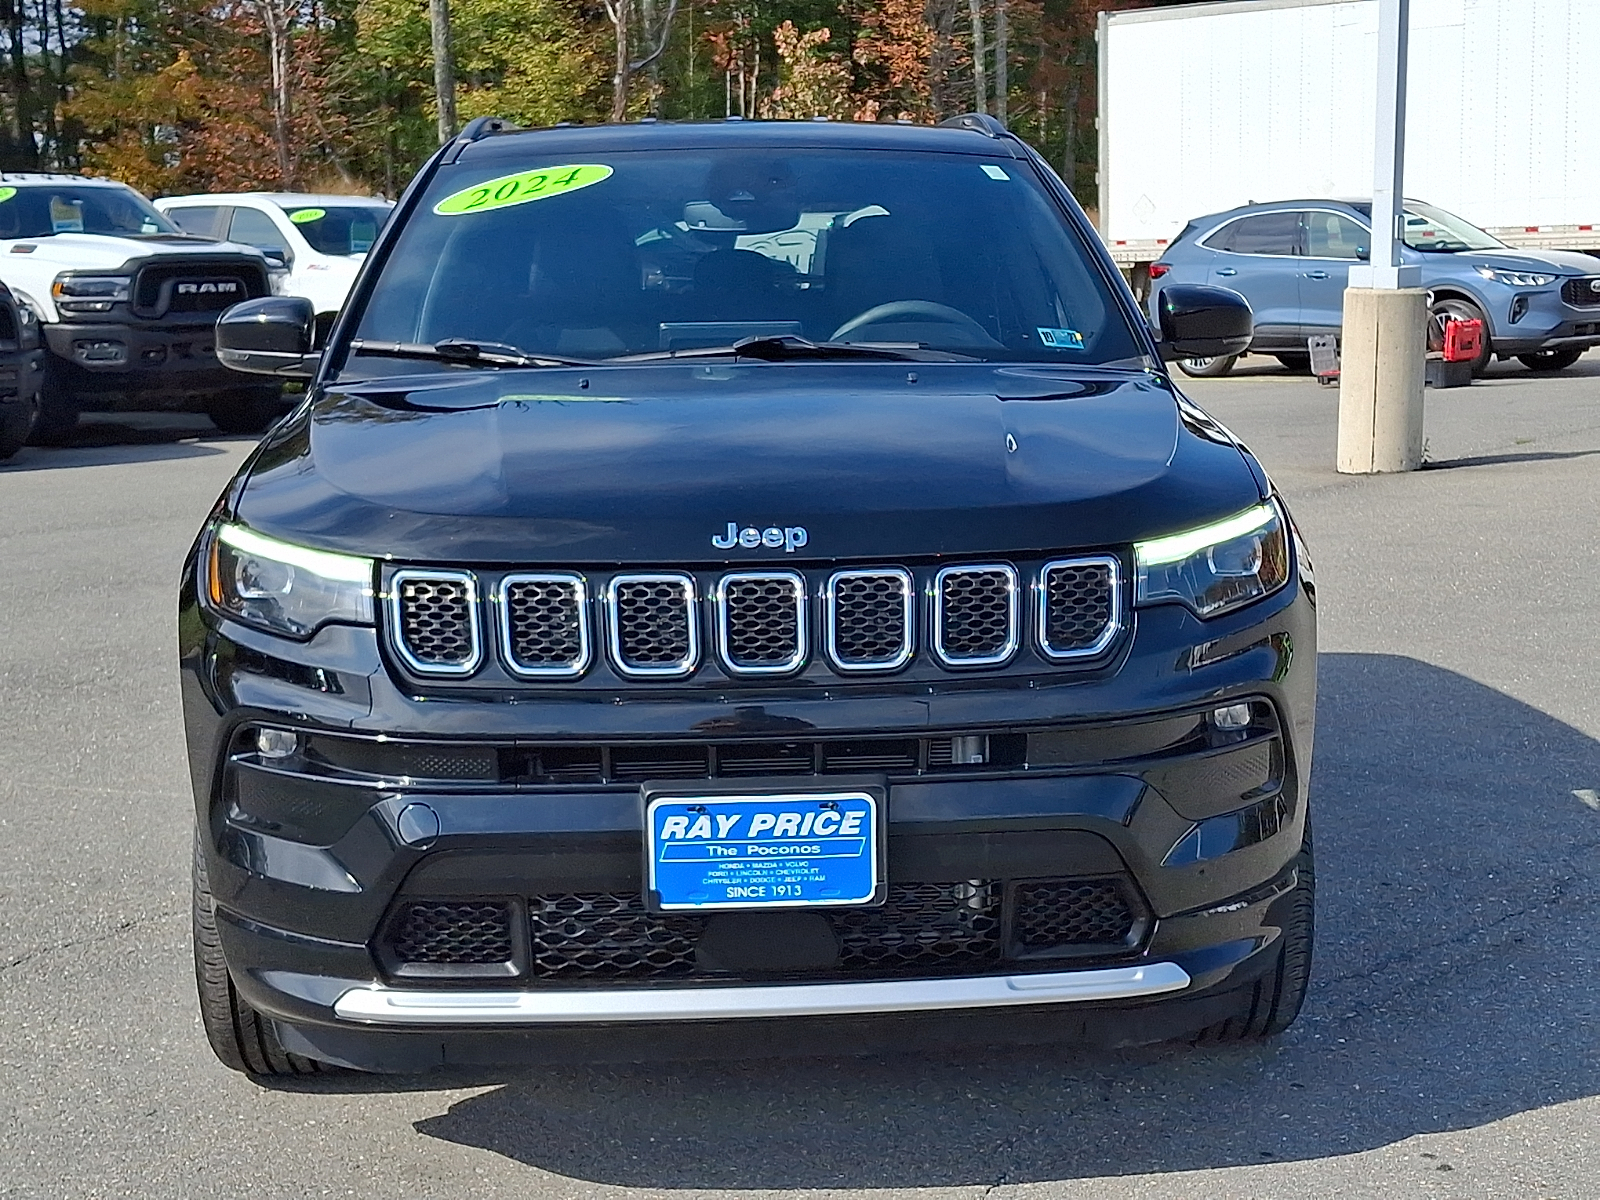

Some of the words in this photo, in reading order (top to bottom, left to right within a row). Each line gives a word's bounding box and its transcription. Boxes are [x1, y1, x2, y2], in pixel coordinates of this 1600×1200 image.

[463, 168, 582, 210] 2024
[178, 282, 237, 294] RAM
[711, 522, 808, 553] Jeep
[660, 814, 742, 840] RAY
[747, 811, 866, 838] PRICE
[706, 845, 738, 857] The
[747, 844, 821, 856] Poconos
[718, 862, 745, 870] HONDA
[752, 861, 778, 869] MAZDA
[785, 860, 809, 868] VOLVO
[736, 869, 769, 877] LINCOLN
[775, 867, 820, 876] CHEVROLET
[726, 886, 767, 899] SINCE
[771, 885, 802, 897] 1913
